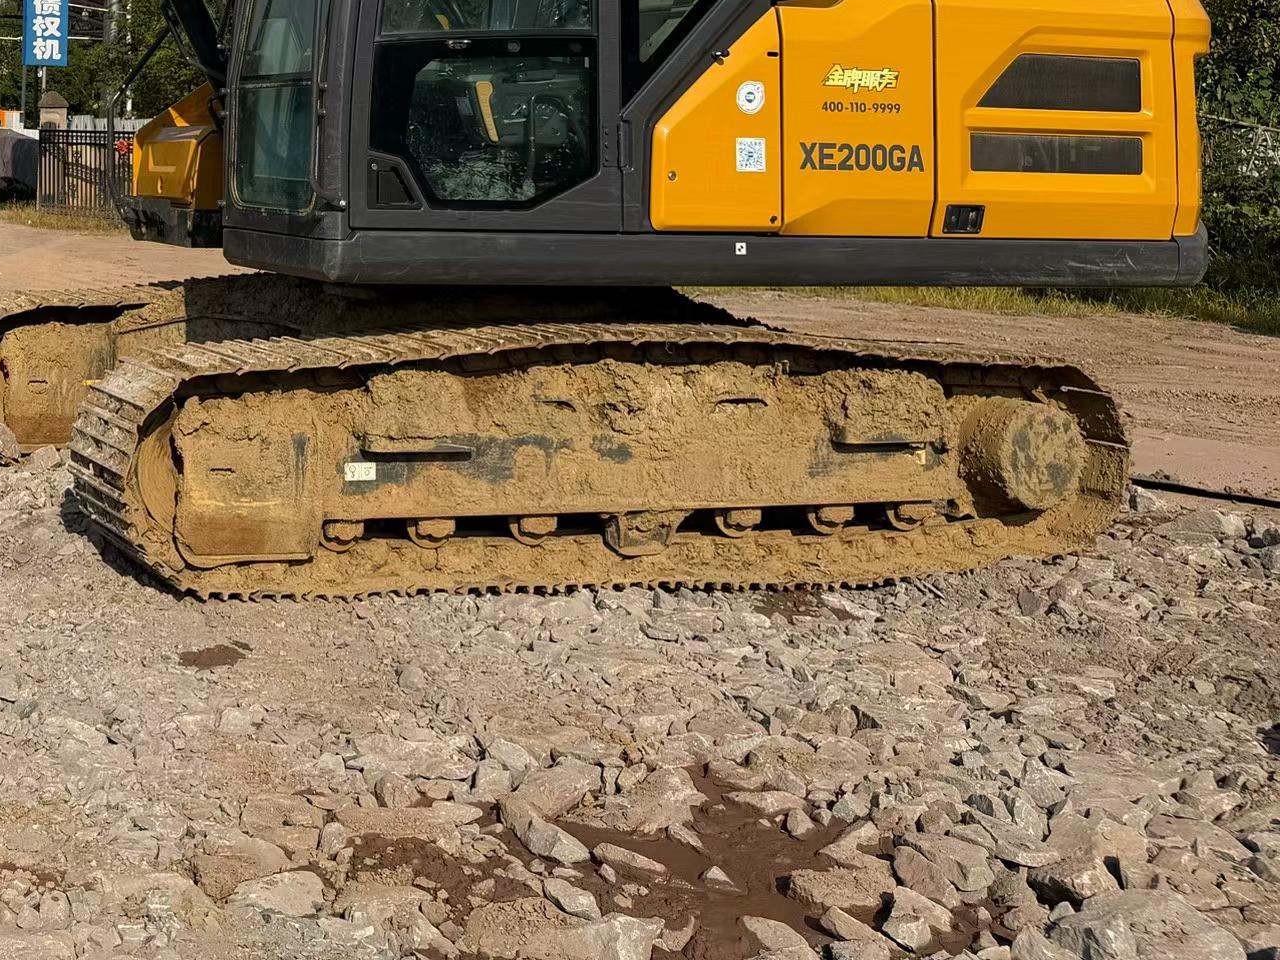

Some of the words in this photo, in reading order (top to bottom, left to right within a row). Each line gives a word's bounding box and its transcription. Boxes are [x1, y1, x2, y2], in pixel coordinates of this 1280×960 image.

[823, 64, 900, 94] 金牌服务
[821, 101, 901, 114] 400-110-9999
[799, 142, 925, 173] XE200GA
